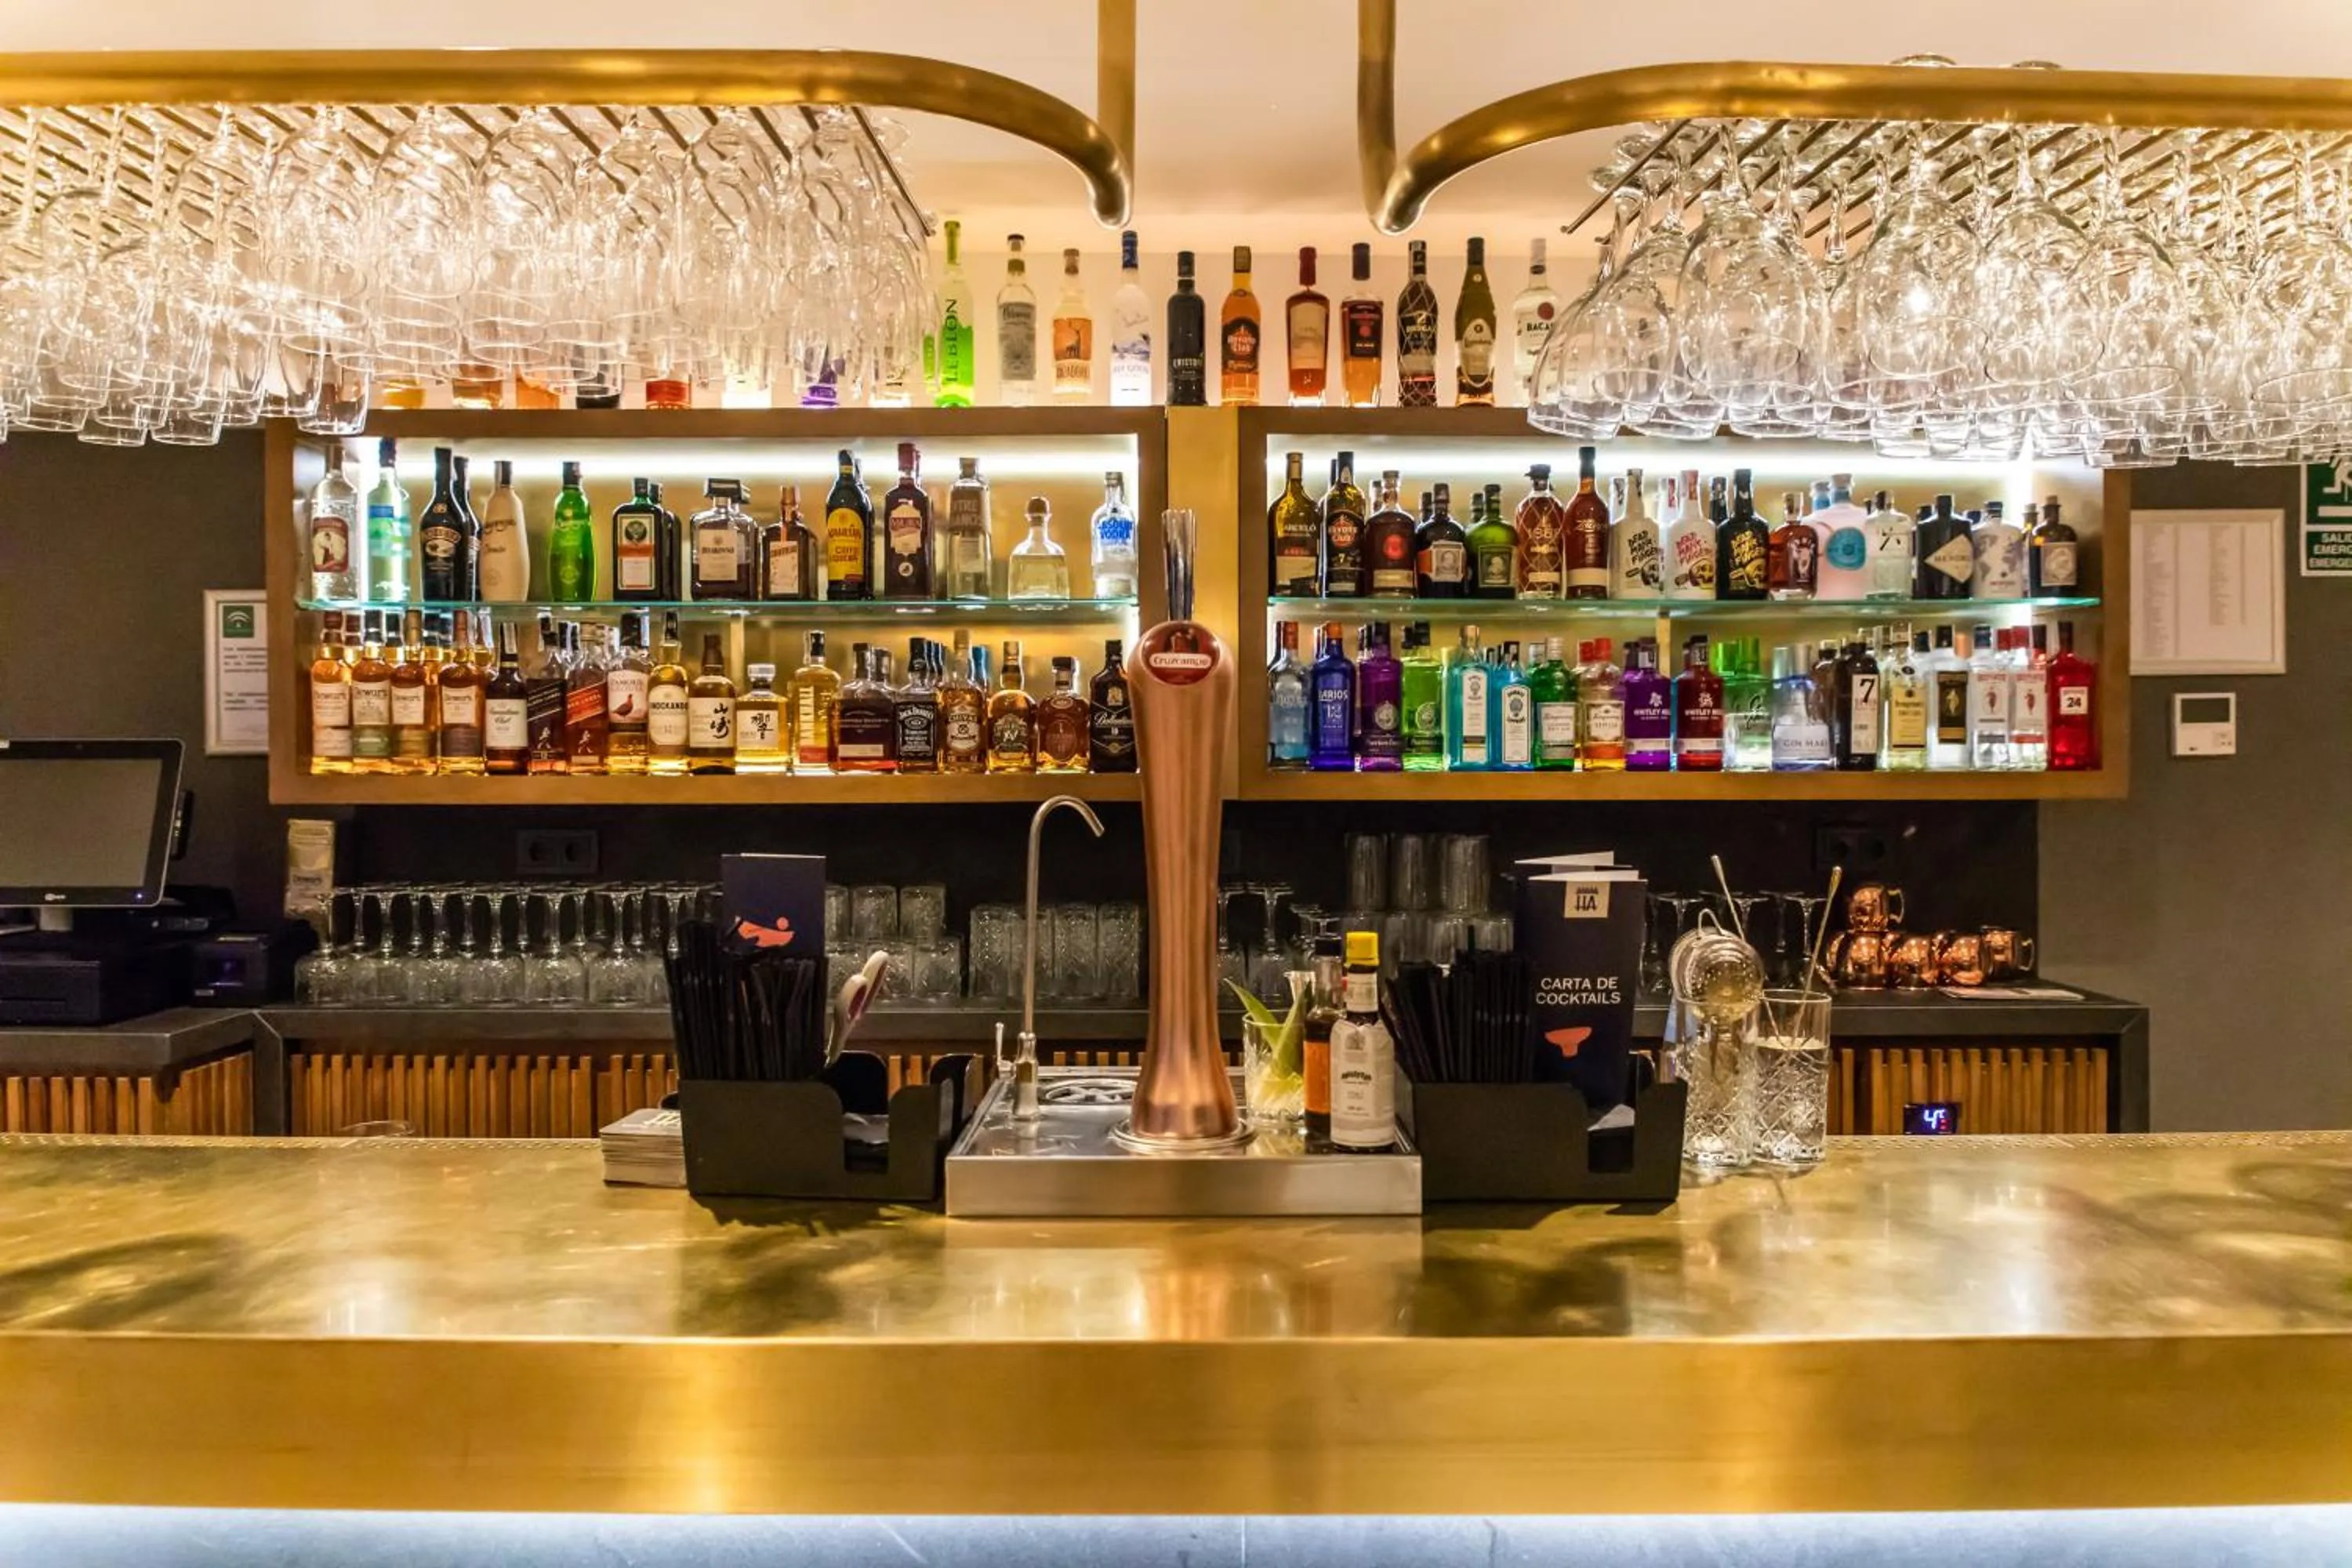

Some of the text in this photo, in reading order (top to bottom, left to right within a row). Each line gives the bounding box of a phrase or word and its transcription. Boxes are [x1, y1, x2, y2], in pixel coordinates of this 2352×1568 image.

[945, 299, 958, 382] LEBLON
[1859, 678, 1876, 704] 7
[2067, 696, 2082, 708] 24
[1541, 977, 1619, 990] CARTA DE
[1536, 992, 1621, 1004] COCKTAILS
